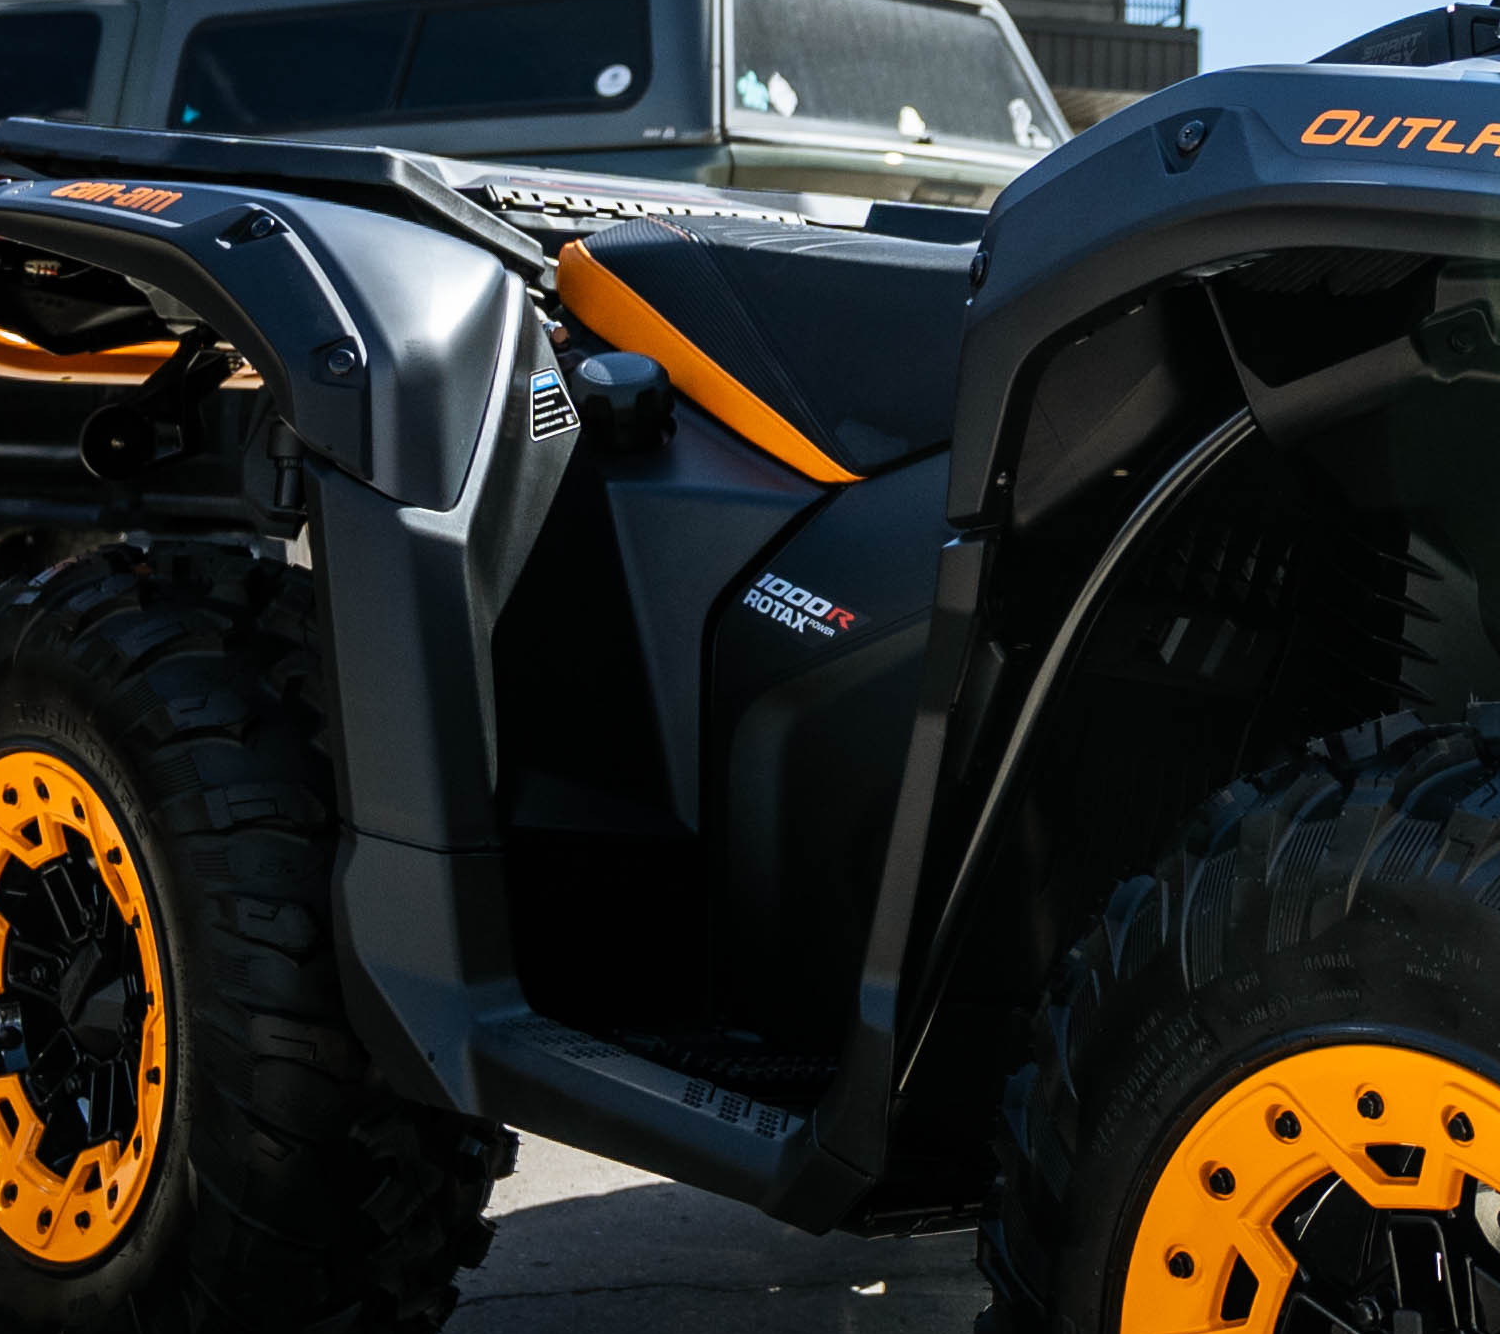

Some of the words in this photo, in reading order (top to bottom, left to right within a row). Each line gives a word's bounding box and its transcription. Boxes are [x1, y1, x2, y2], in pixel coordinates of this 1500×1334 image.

[51, 181, 182, 213] can-am
[743, 588, 810, 634] ROTAX
[807, 618, 836, 637] POWER
[756, 573, 856, 630] 1000R
